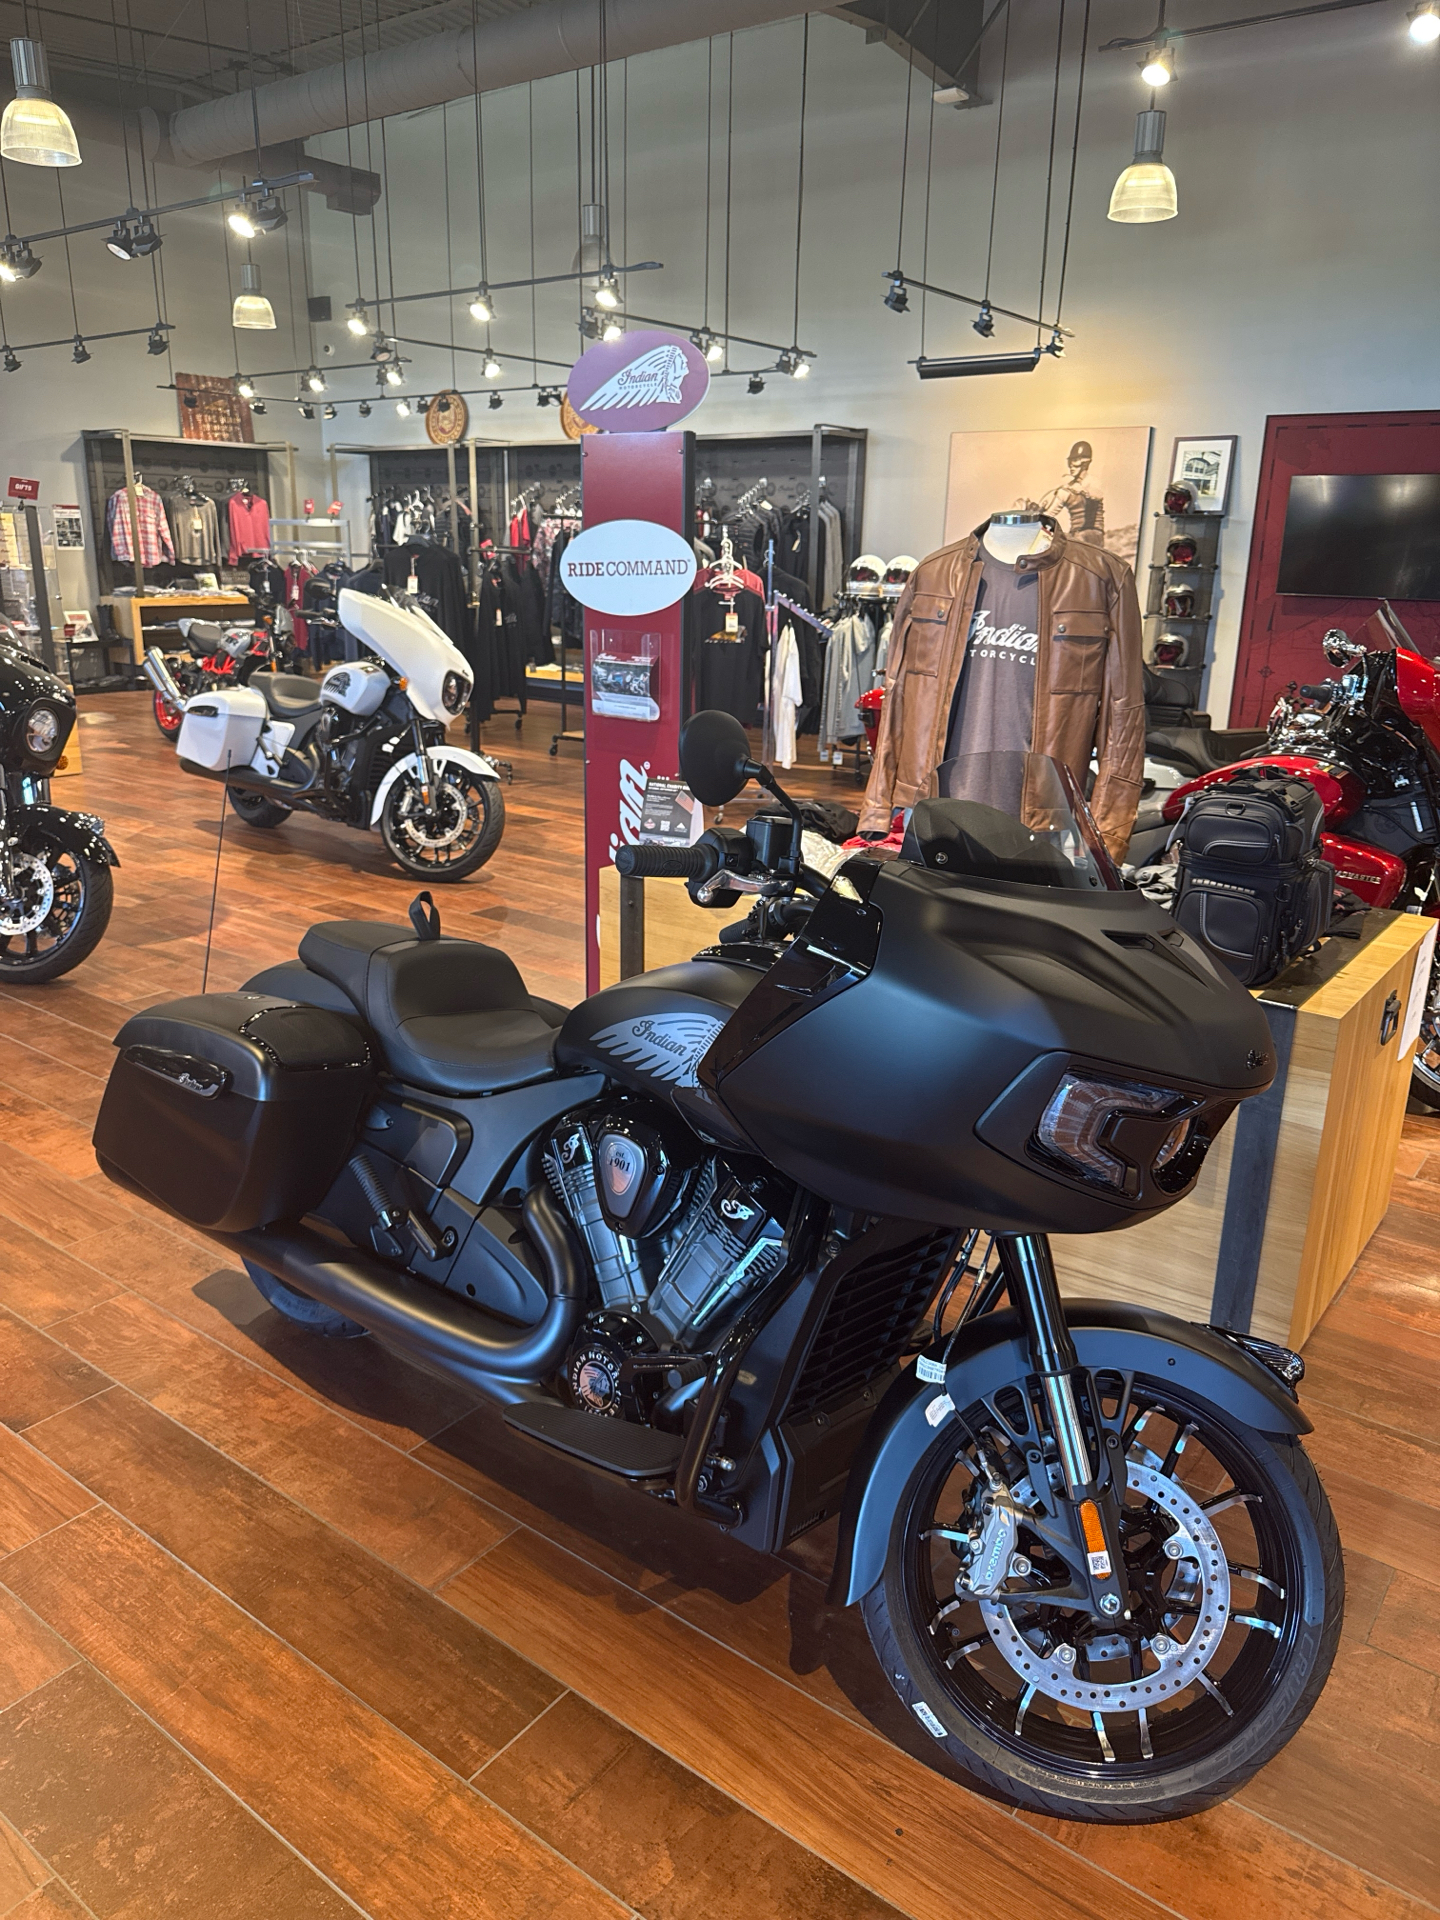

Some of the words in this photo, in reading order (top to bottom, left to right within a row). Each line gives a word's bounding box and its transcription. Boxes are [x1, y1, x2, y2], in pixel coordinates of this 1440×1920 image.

[617, 368, 659, 386] Indian
[567, 562, 605, 578] RIDE
[632, 1020, 688, 1056] Indian
[609, 1157, 631, 1172] 1901
